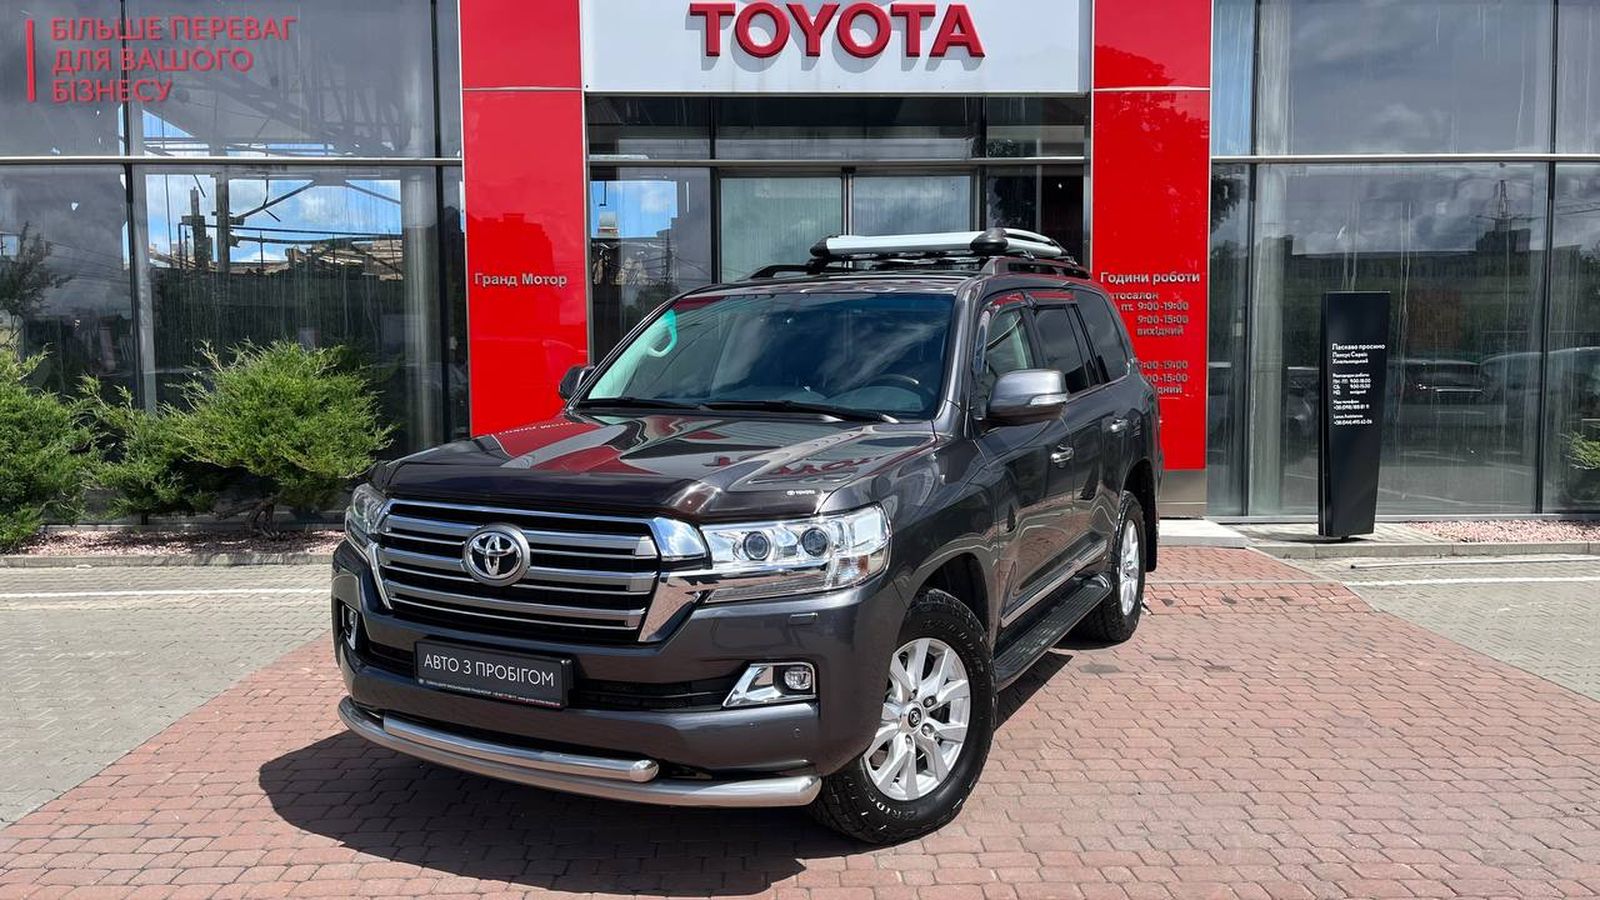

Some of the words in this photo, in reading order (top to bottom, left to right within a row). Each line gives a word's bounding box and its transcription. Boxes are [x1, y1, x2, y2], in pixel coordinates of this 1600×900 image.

[51, 17, 162, 41] БІЛЬШЕ
[170, 16, 297, 41] ПЕРЕВАГ
[689, 1, 985, 58] TOYOTA
[53, 48, 112, 75] ДЛЯ
[121, 47, 254, 72] ВАШОГО
[52, 79, 173, 102] БІЗНЕСУ
[474, 272, 518, 288] Гранд
[522, 272, 567, 288] Мотор
[1100, 272, 1149, 284] Години
[1153, 271, 1200, 285] роботи
[1111, 292, 1159, 300] тосалон
[1137, 326, 1184, 336] вихідний
[1157, 384, 1183, 394] дний
[424, 653, 459, 672] АВТО
[463, 660, 472, 674] З
[475, 661, 554, 687] ПРОБІГОМ
